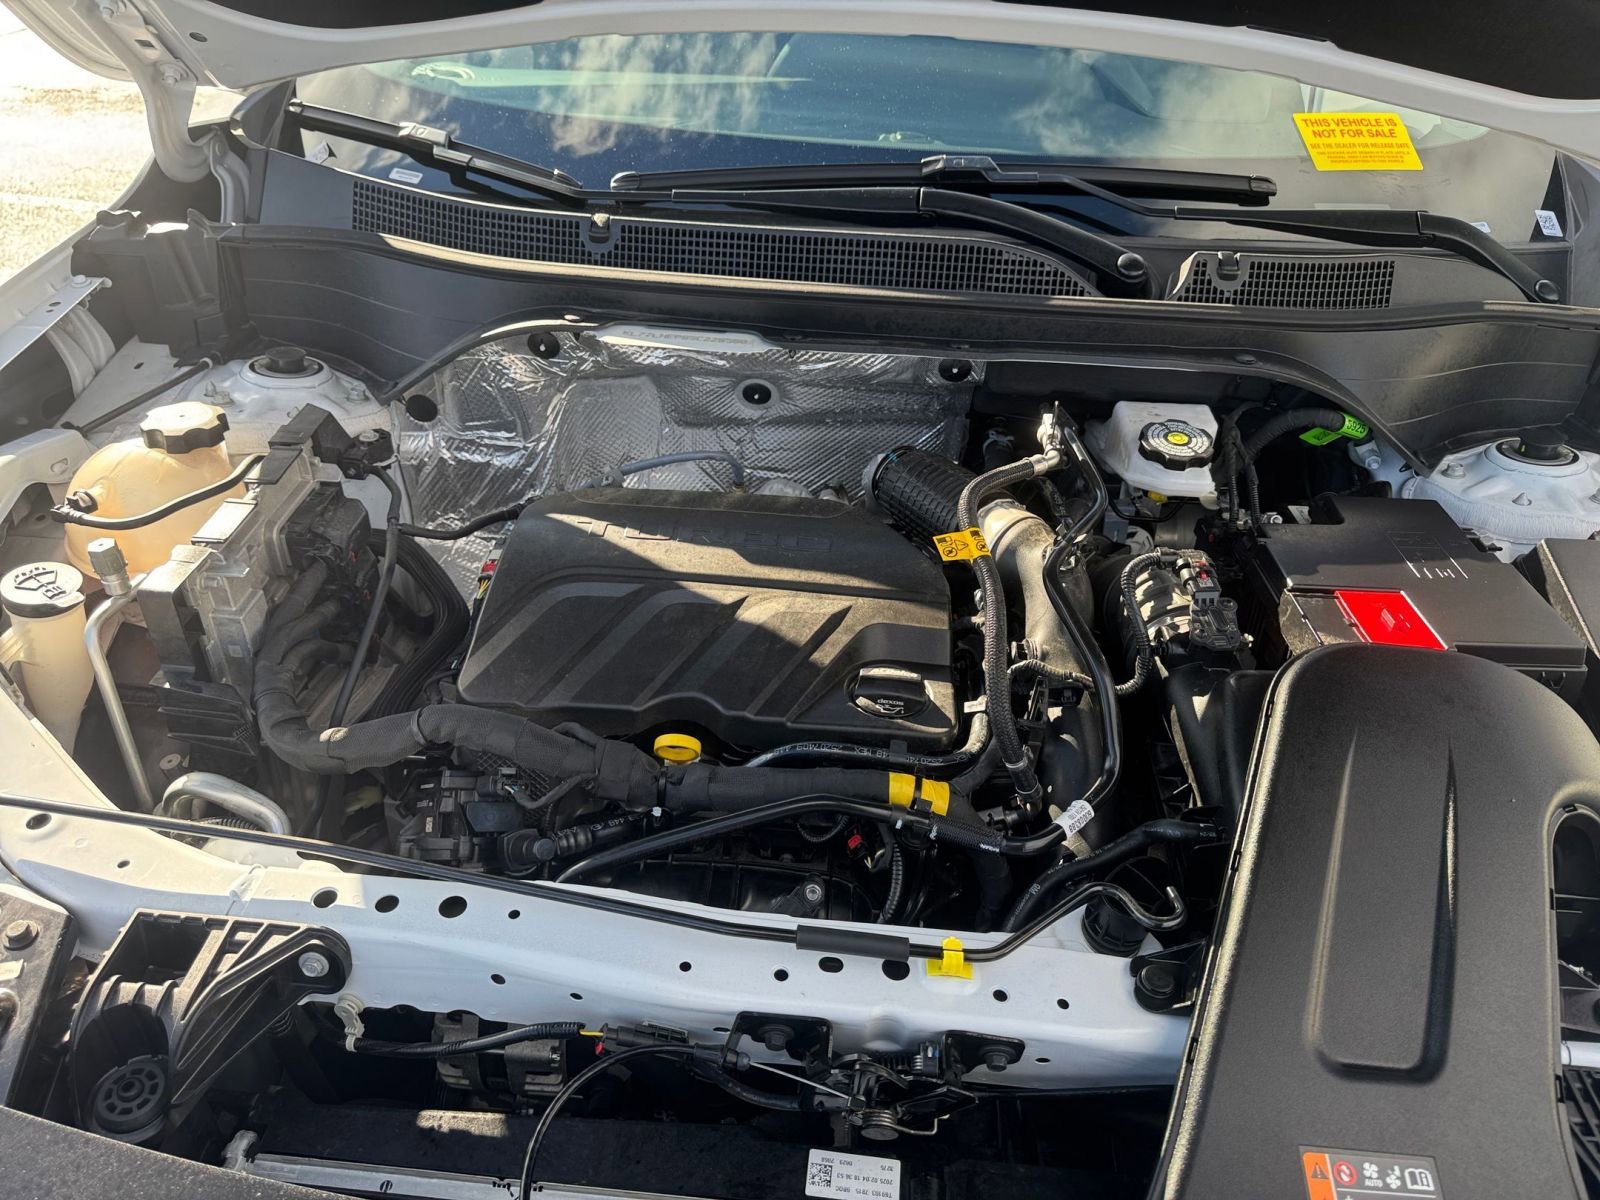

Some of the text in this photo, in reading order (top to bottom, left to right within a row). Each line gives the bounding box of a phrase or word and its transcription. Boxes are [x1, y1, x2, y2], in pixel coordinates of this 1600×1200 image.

[1302, 118, 1397, 127] THIS VEHICLE IS
[1312, 129, 1398, 138] NOT FOR SALE
[877, 698, 904, 706] dexos
[1364, 1178, 1384, 1188] AUTO
